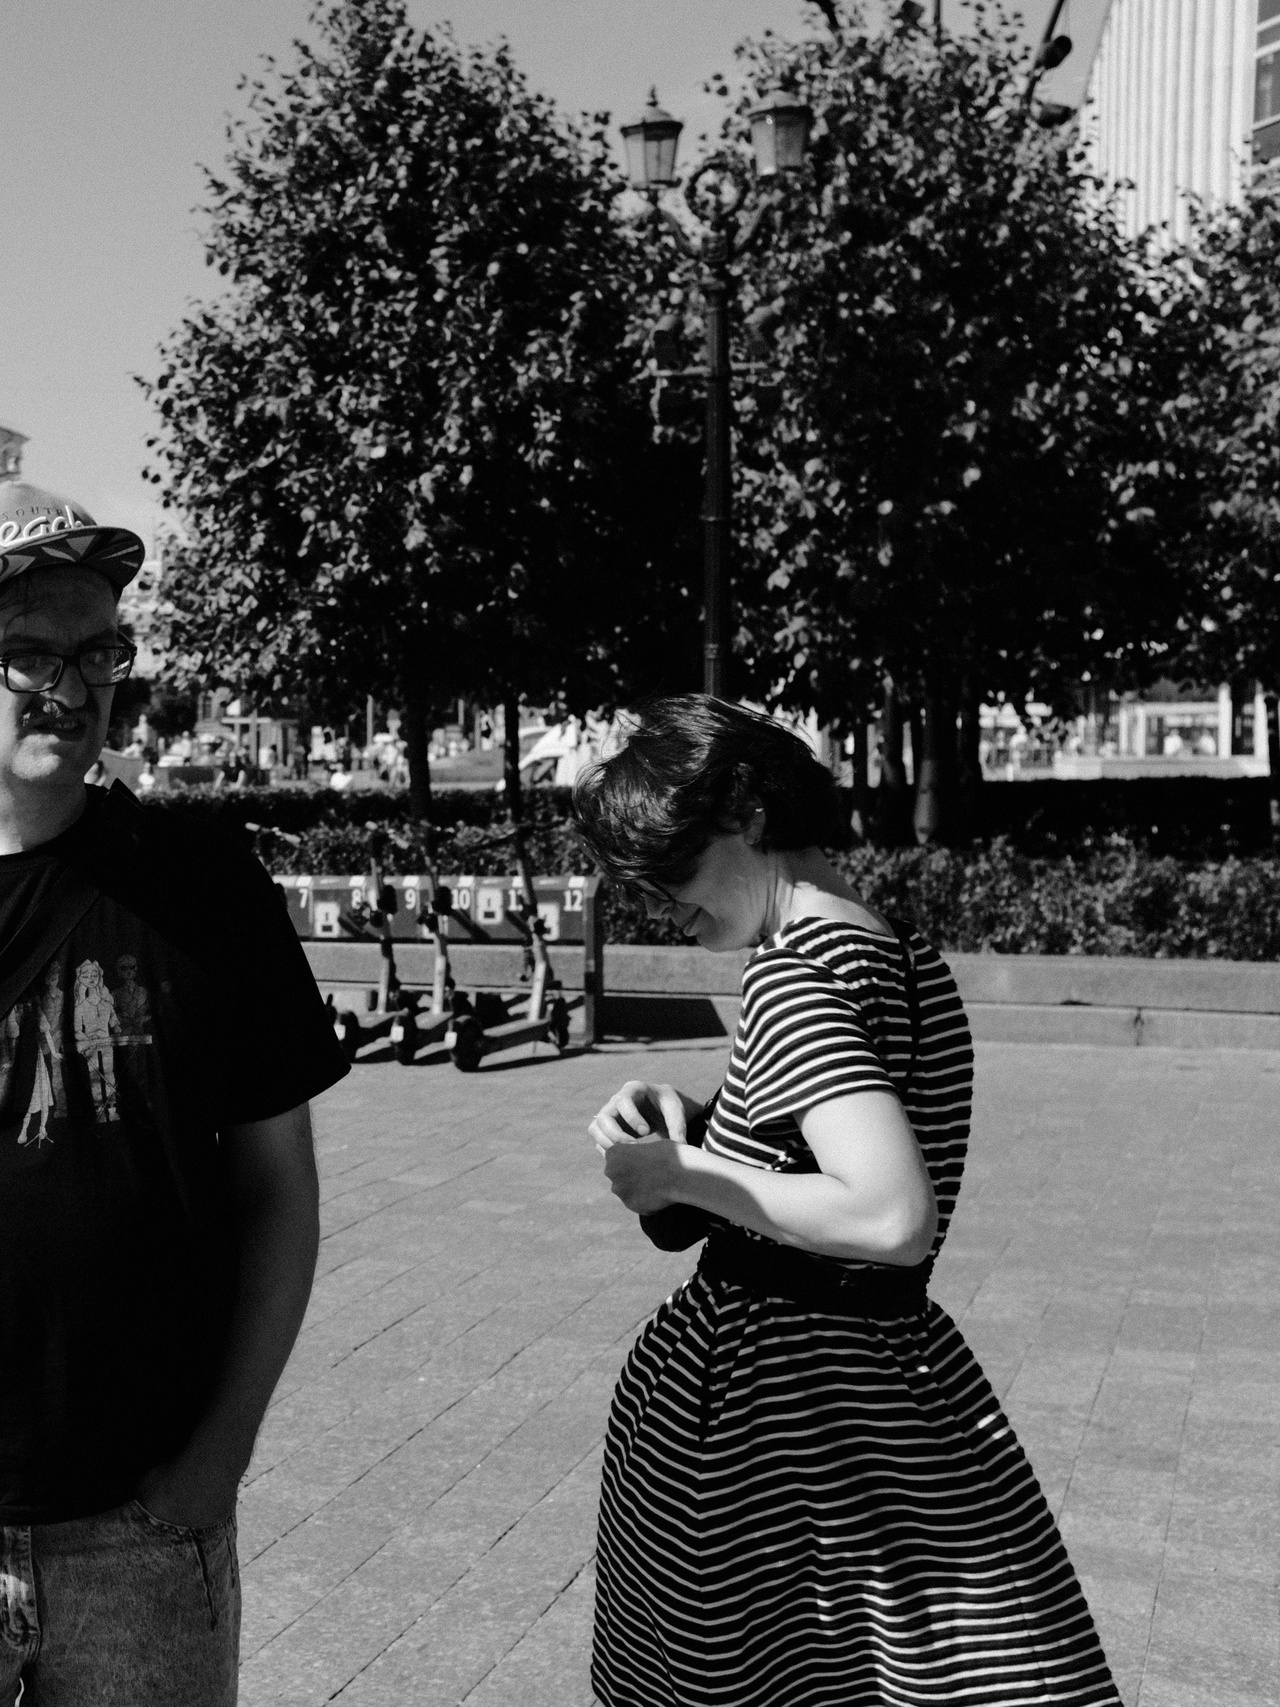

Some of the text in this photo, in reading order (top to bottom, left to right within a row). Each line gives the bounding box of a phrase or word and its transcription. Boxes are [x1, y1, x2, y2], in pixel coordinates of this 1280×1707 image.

[1, 505, 63, 522] SOUTH
[298, 888, 309, 909] 7
[351, 888, 362, 909] 8
[404, 888, 416, 909] 9
[451, 888, 471, 910] 10
[564, 889, 583, 911] 12
